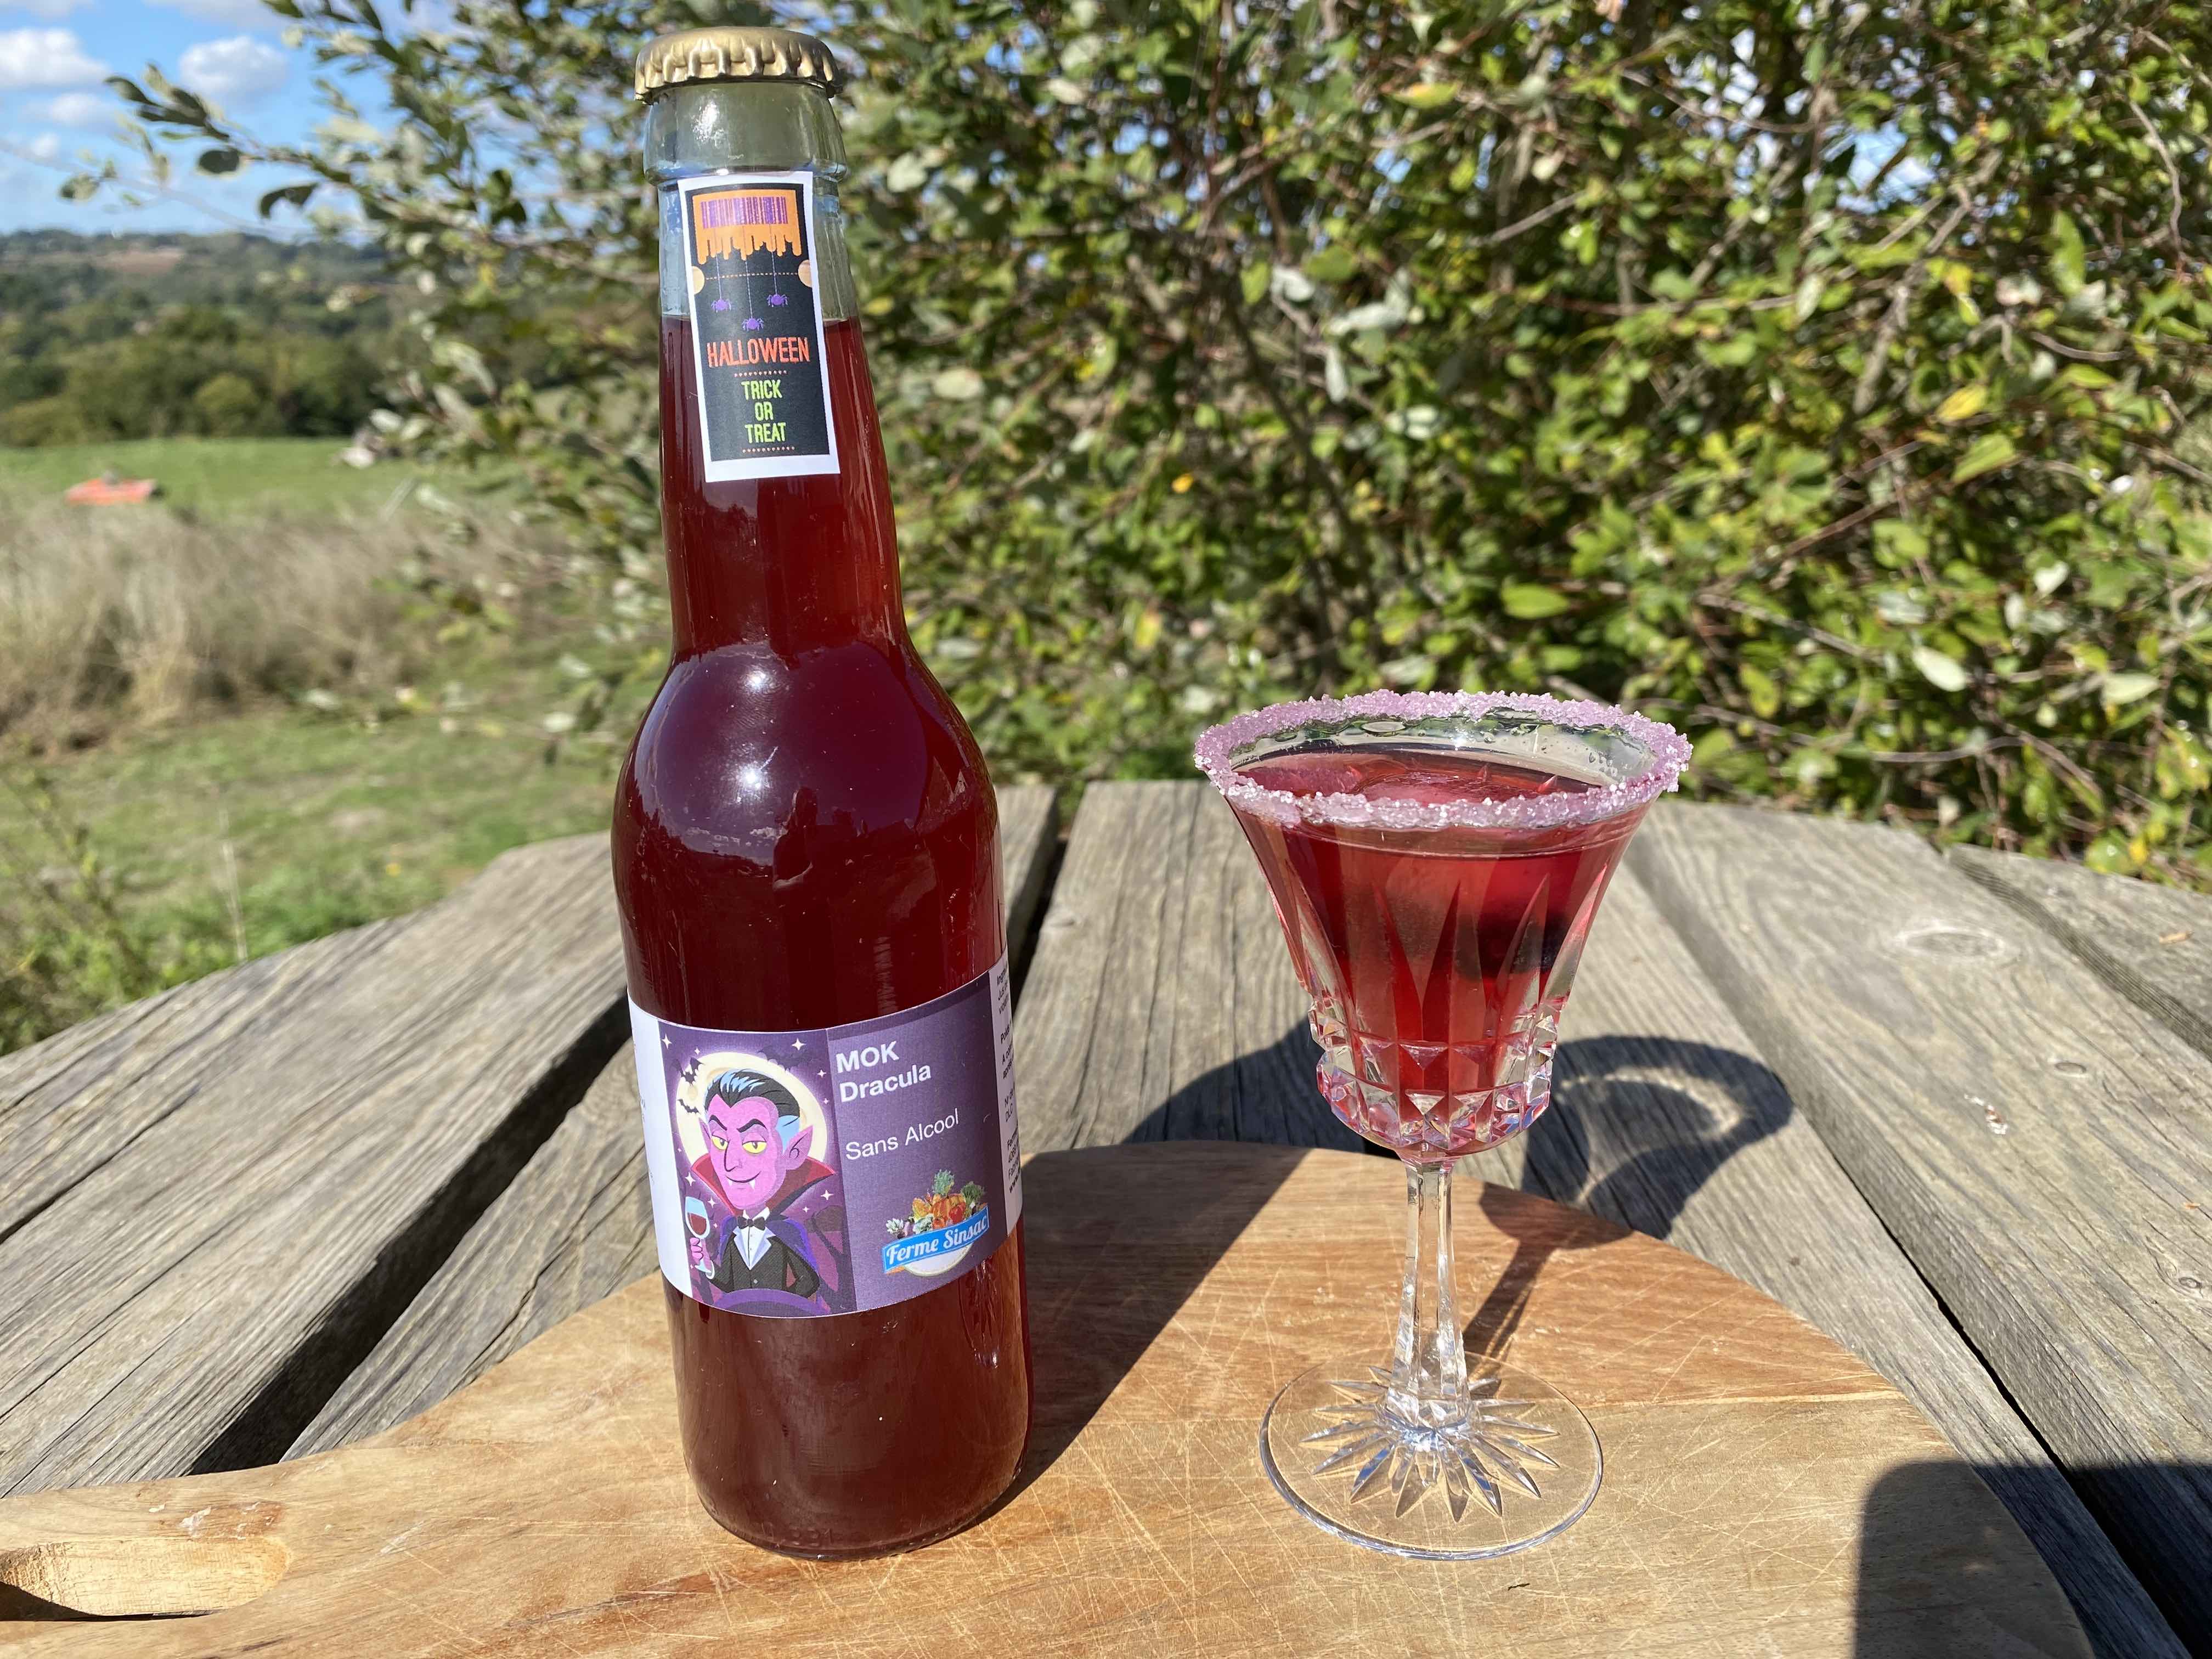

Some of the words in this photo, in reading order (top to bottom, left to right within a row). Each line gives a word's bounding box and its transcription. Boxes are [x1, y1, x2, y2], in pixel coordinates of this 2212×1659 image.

[707, 336, 810, 368] HALLOWEEN
[741, 379, 782, 400] TRICK
[754, 401, 774, 421] OR
[744, 422, 786, 444] TREAT
[836, 1040, 900, 1074] MOK
[839, 1064, 932, 1102] Dracula
[845, 1136, 899, 1160] Sans
[905, 1108, 959, 1146] Alcool
[885, 1237, 939, 1265] Ferme
[943, 1215, 987, 1249] Sinsac
